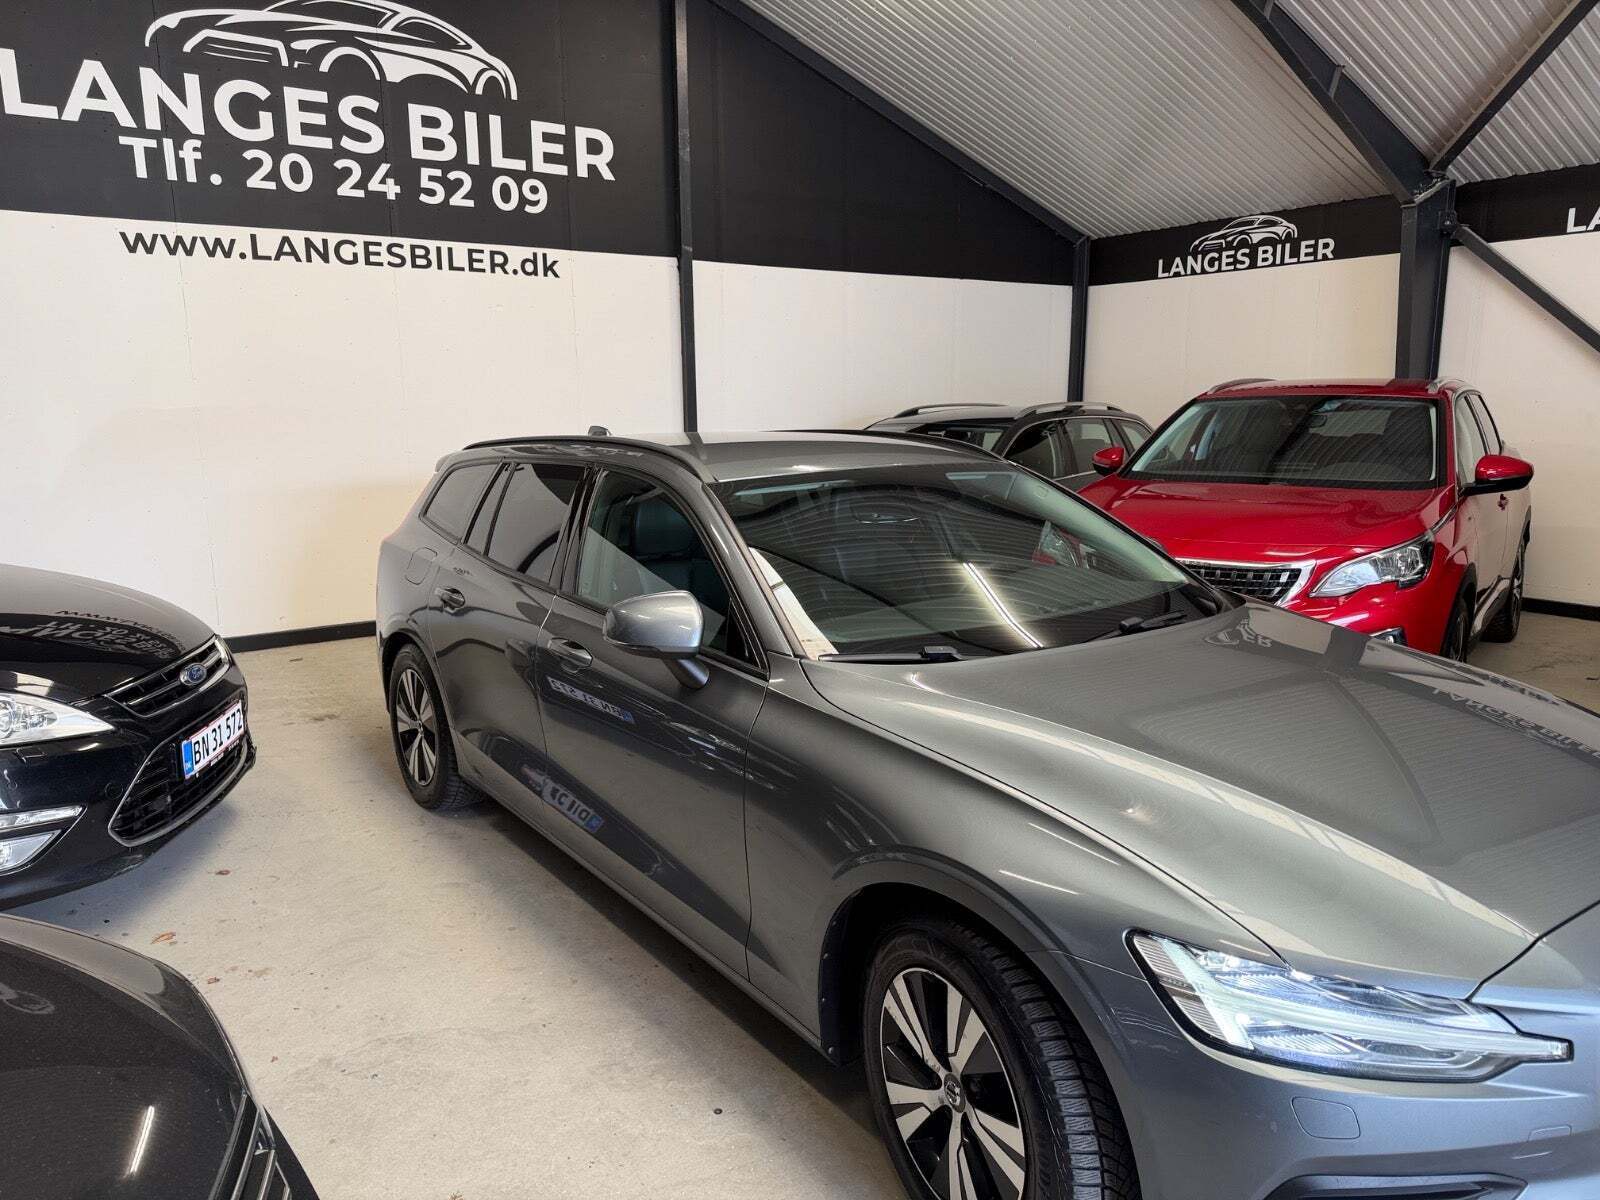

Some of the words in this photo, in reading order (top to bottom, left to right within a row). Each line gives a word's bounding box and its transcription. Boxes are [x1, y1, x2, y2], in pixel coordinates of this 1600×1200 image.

[0, 48, 384, 155] LANGES
[408, 103, 616, 181] BILER
[119, 136, 223, 186] Tlf.
[242, 149, 313, 193] 20
[334, 159, 401, 201] 24
[419, 168, 475, 208] 52
[492, 176, 548, 214] 09
[119, 231, 560, 279] www.LANGESBILER.dk
[1157, 245, 1250, 278] LANGES
[1257, 237, 1335, 266] BILER
[193, 732, 210, 765] BN
[211, 725, 224, 752] 31
[225, 708, 243, 740] 572
